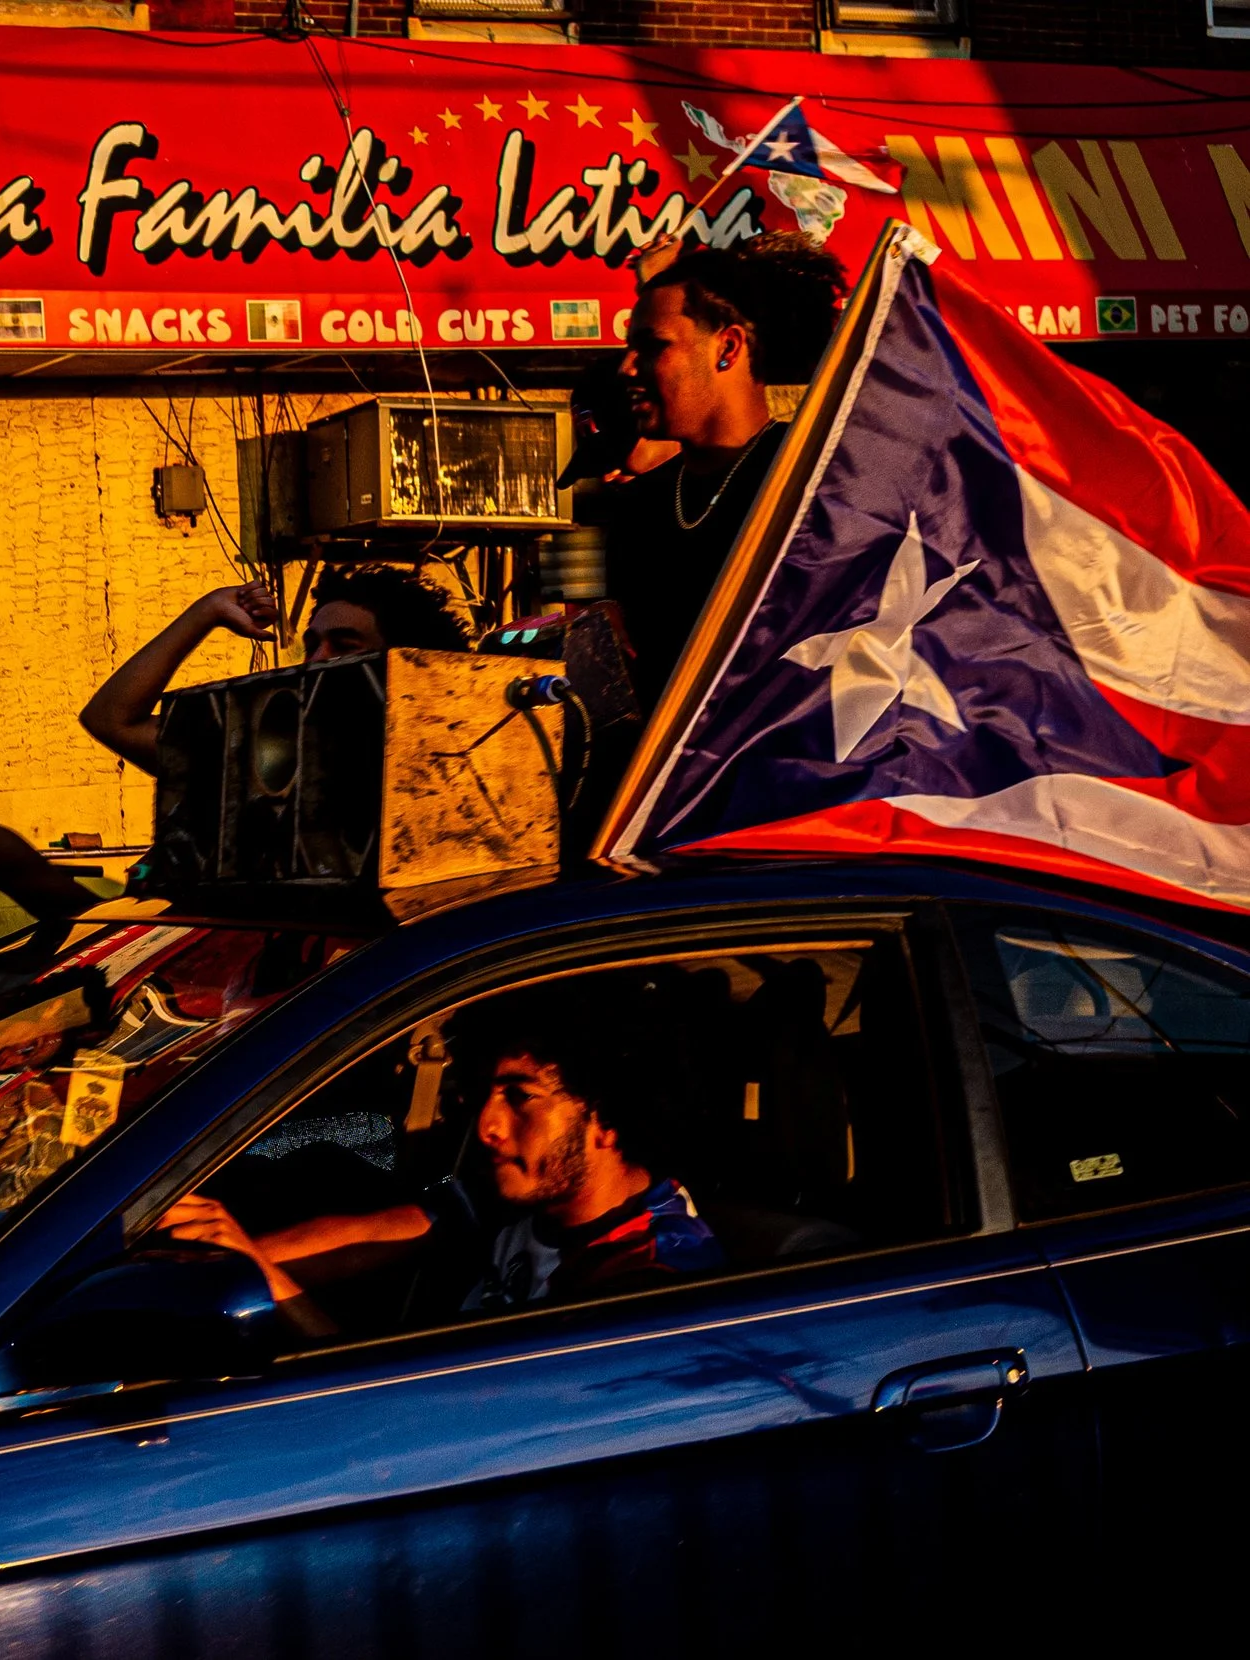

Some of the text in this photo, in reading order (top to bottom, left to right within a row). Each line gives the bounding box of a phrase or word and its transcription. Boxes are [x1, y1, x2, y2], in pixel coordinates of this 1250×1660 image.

[78, 121, 472, 274] Familia
[495, 129, 762, 264] Latina
[885, 135, 1187, 261] MINI
[69, 308, 232, 343] SNACKS
[320, 309, 535, 343] COLD CUTS
[1151, 305, 1201, 333] PET
